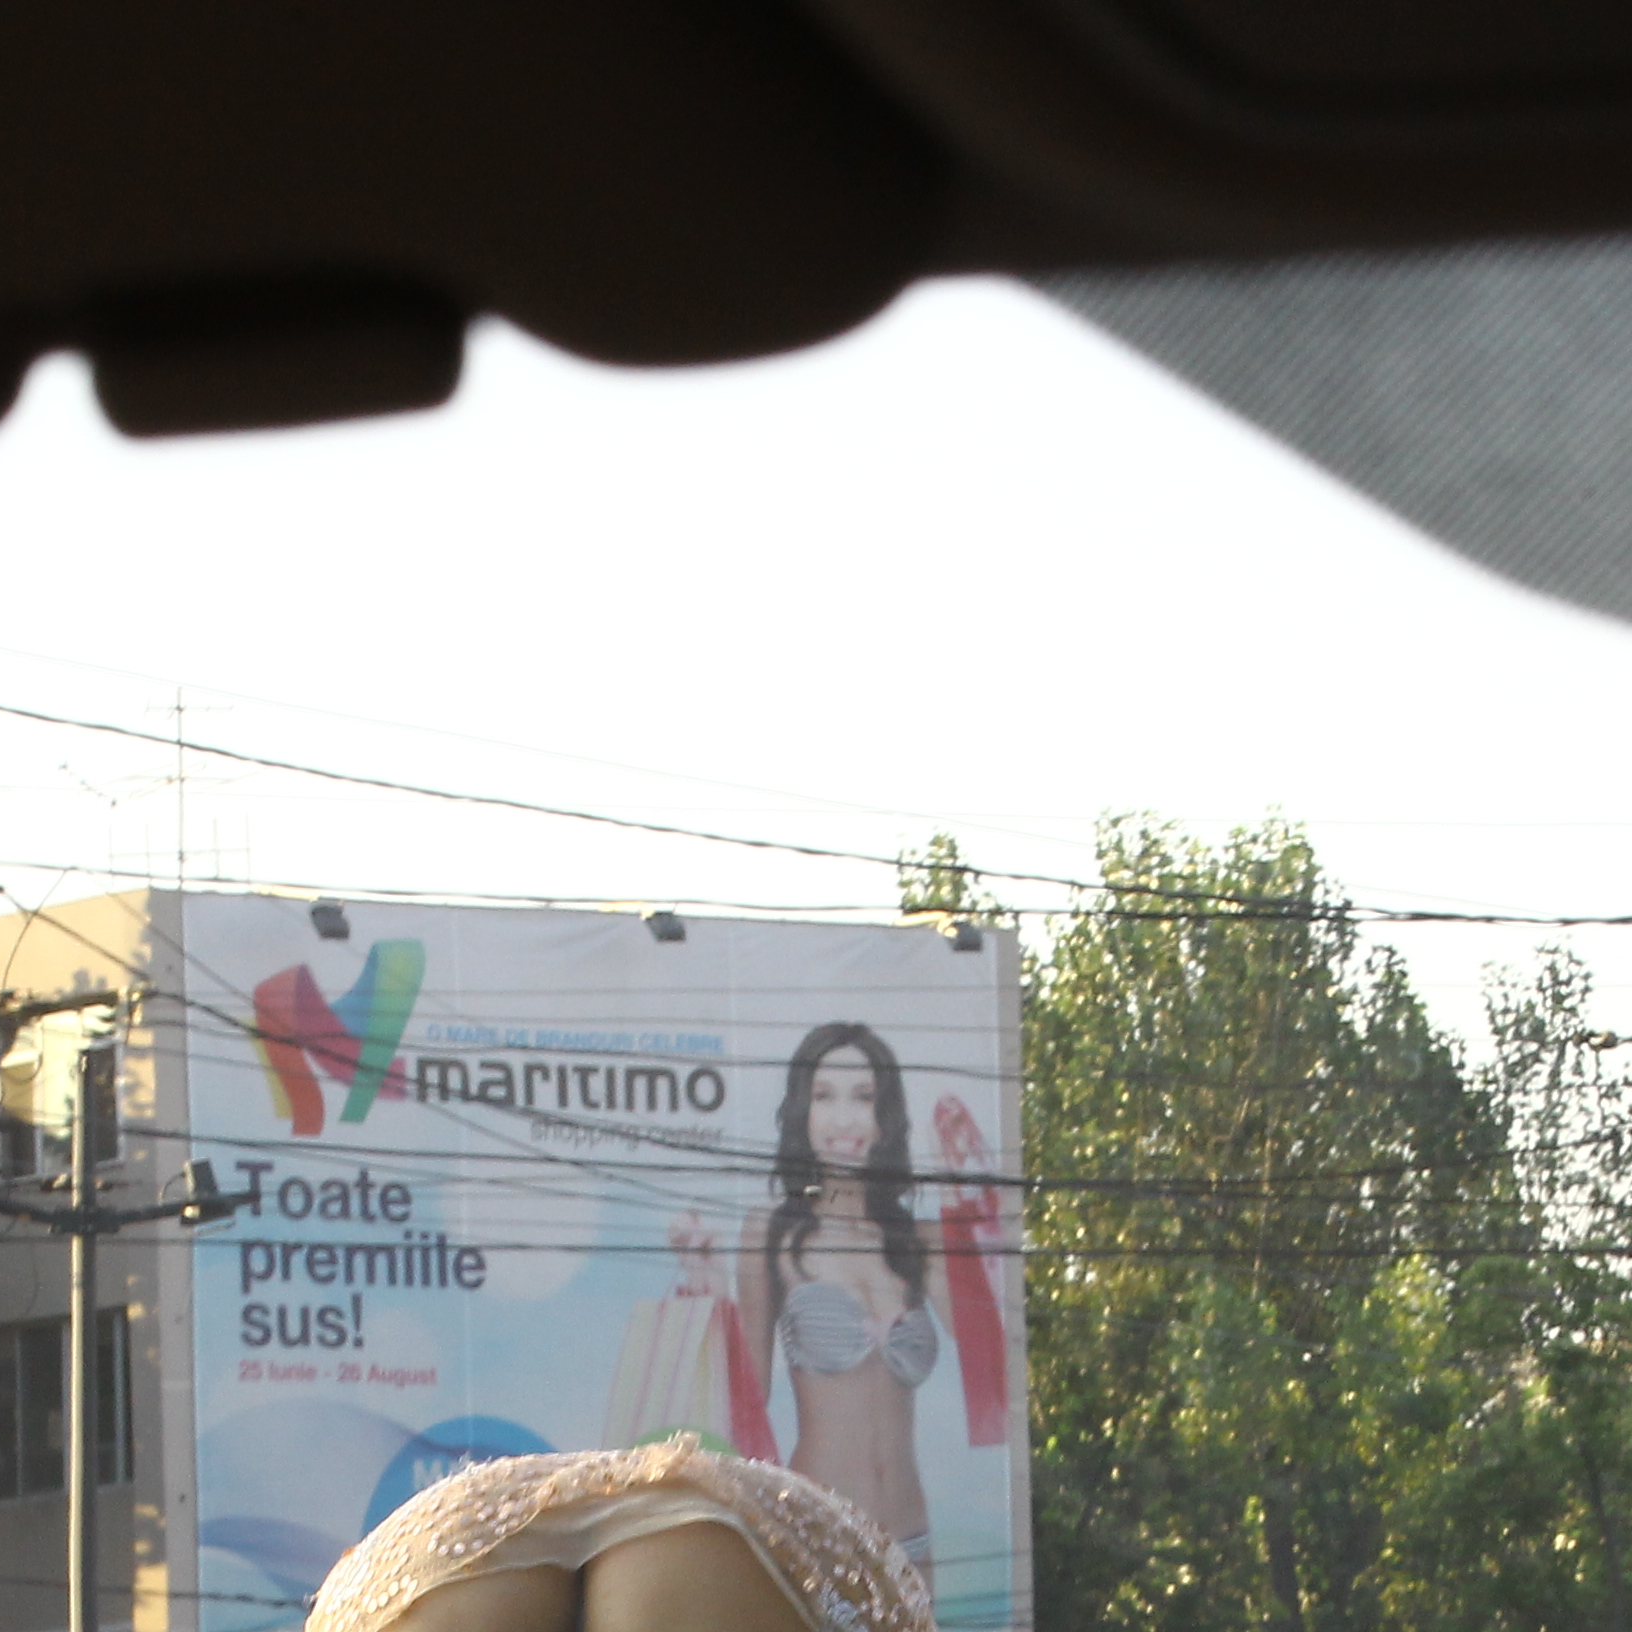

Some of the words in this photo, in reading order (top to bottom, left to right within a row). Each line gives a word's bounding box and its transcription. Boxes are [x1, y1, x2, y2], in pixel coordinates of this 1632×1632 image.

[416, 1056, 726, 1113] maritimo
[235, 1160, 413, 1223] Toate
[240, 1229, 486, 1295] premiile
[240, 1293, 365, 1349] sus!
[238, 1360, 264, 1382] 25
[269, 1361, 317, 1383] Iunie
[368, 1363, 437, 1388] August
